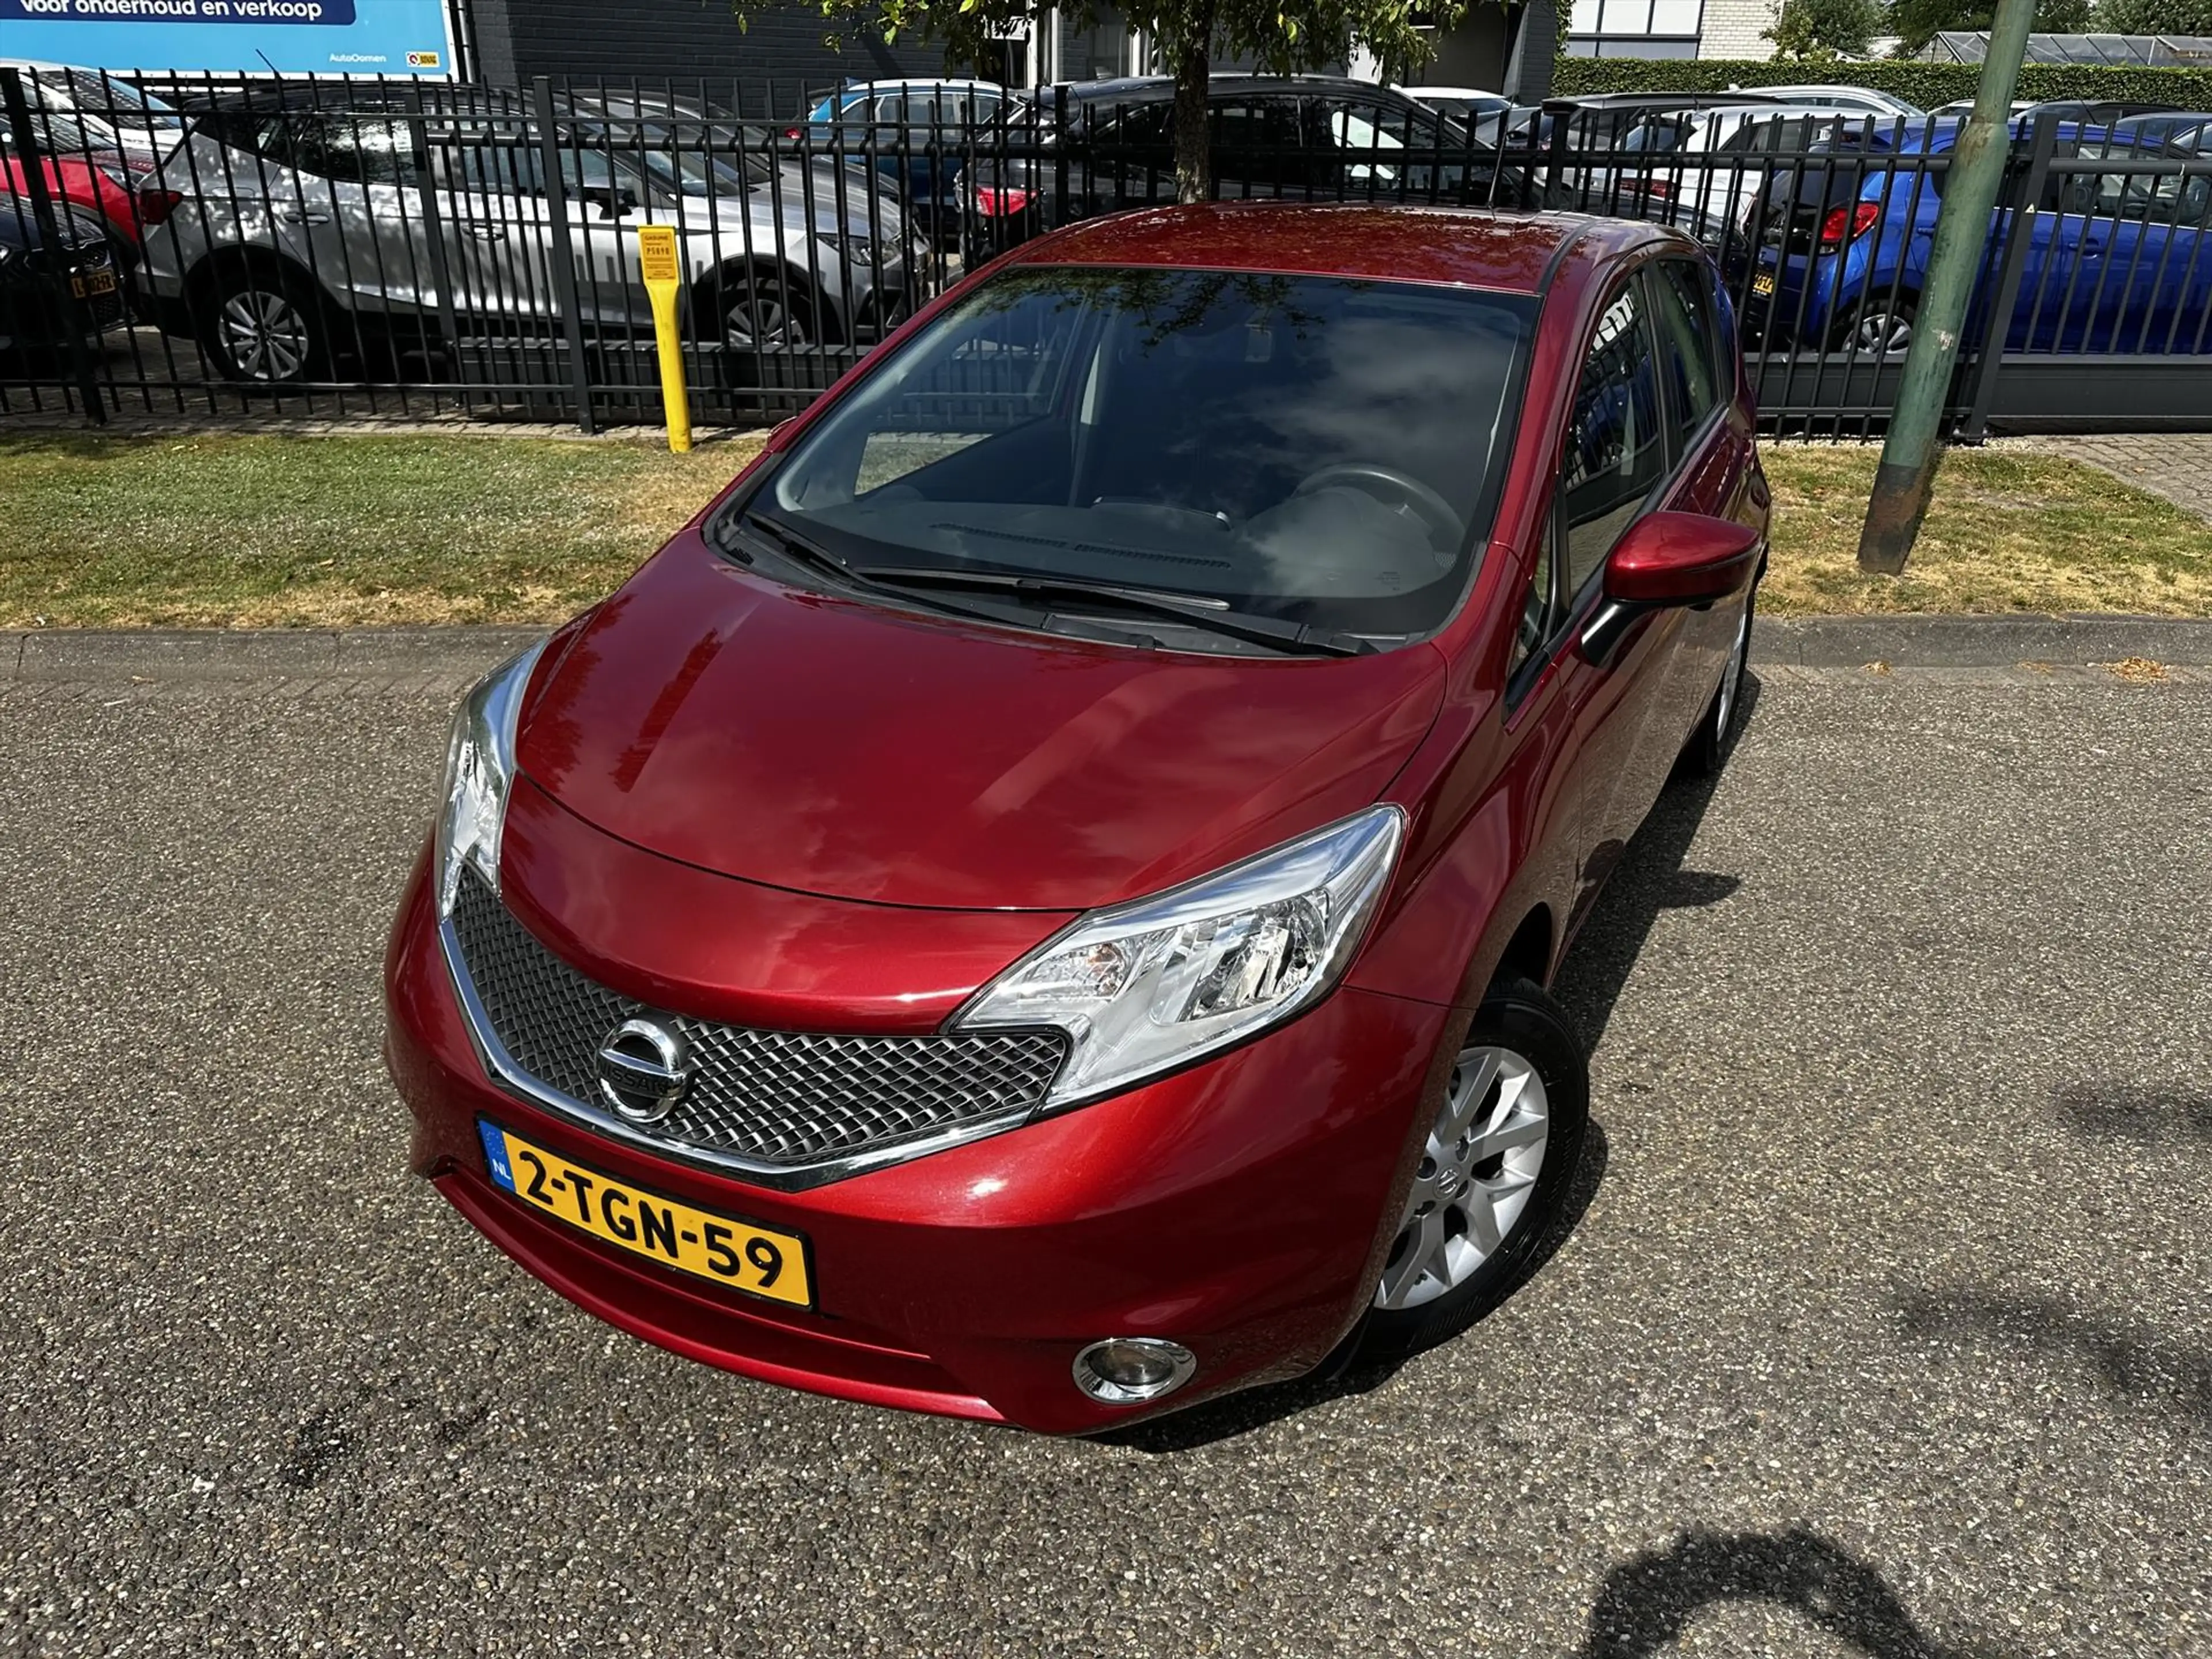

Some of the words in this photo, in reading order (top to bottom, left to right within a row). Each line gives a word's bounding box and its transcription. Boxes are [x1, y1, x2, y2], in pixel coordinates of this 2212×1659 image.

[20, 0, 69, 13] voor
[75, 0, 197, 14] onderhoud
[202, 1, 229, 16] en
[233, 0, 322, 21] verkoop
[329, 53, 387, 63] AutoOomen
[492, 1158, 512, 1180] NL
[519, 1150, 783, 1289] 2-TGN-59
